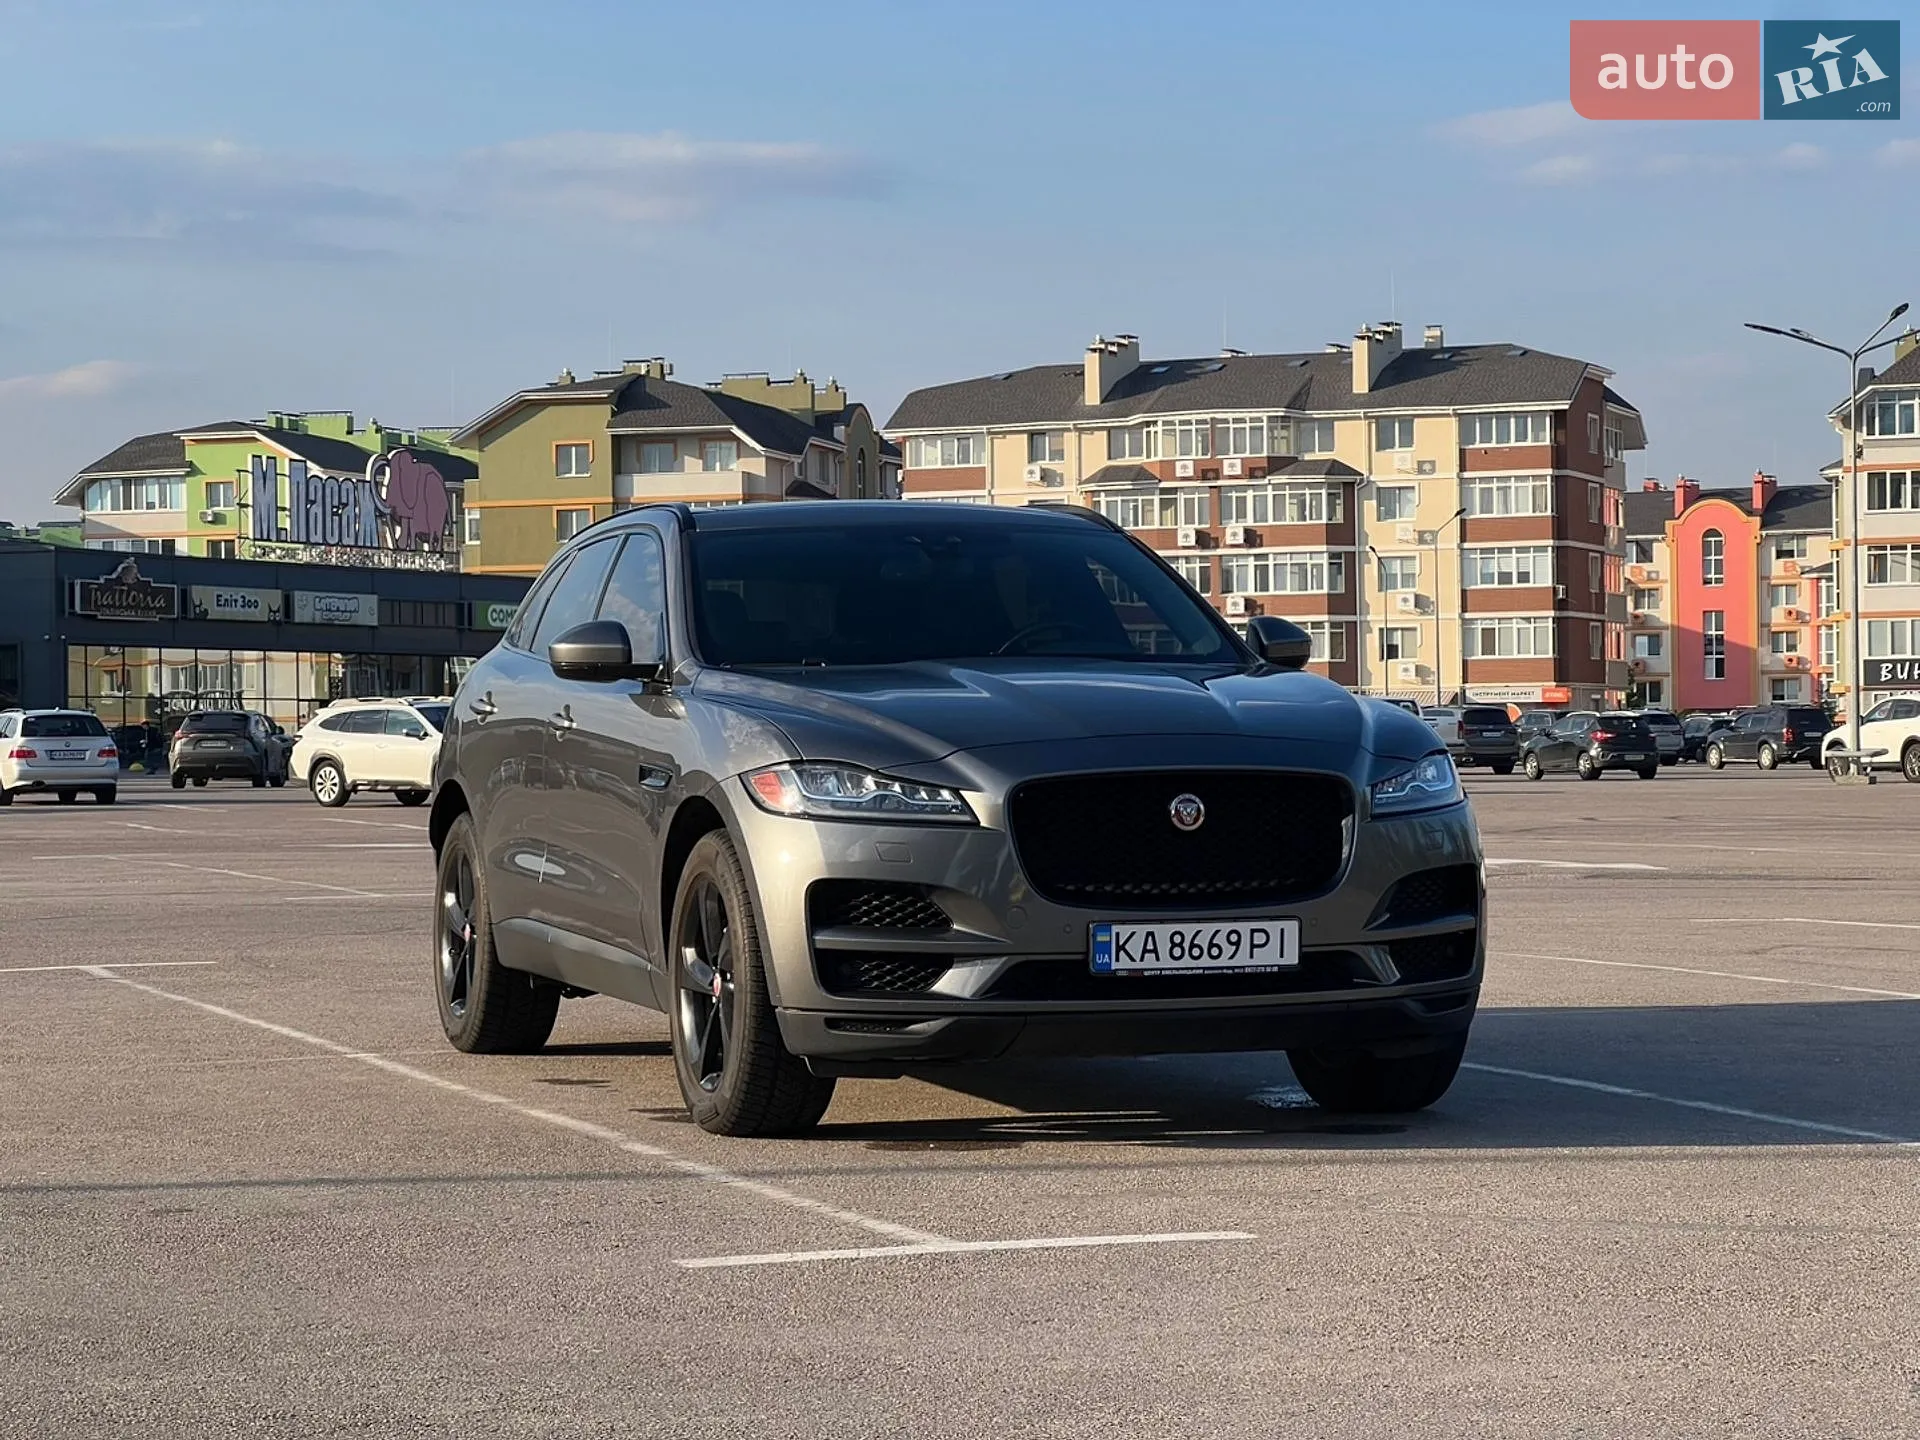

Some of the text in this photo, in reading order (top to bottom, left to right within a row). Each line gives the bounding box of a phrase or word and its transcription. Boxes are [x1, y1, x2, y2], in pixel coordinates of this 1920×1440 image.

[88, 584, 168, 610] Trattoria
[215, 594, 260, 610] Еліт Зоо
[1115, 931, 1161, 962] KA
[1168, 929, 1242, 961] 8669
[1096, 954, 1111, 964] UA
